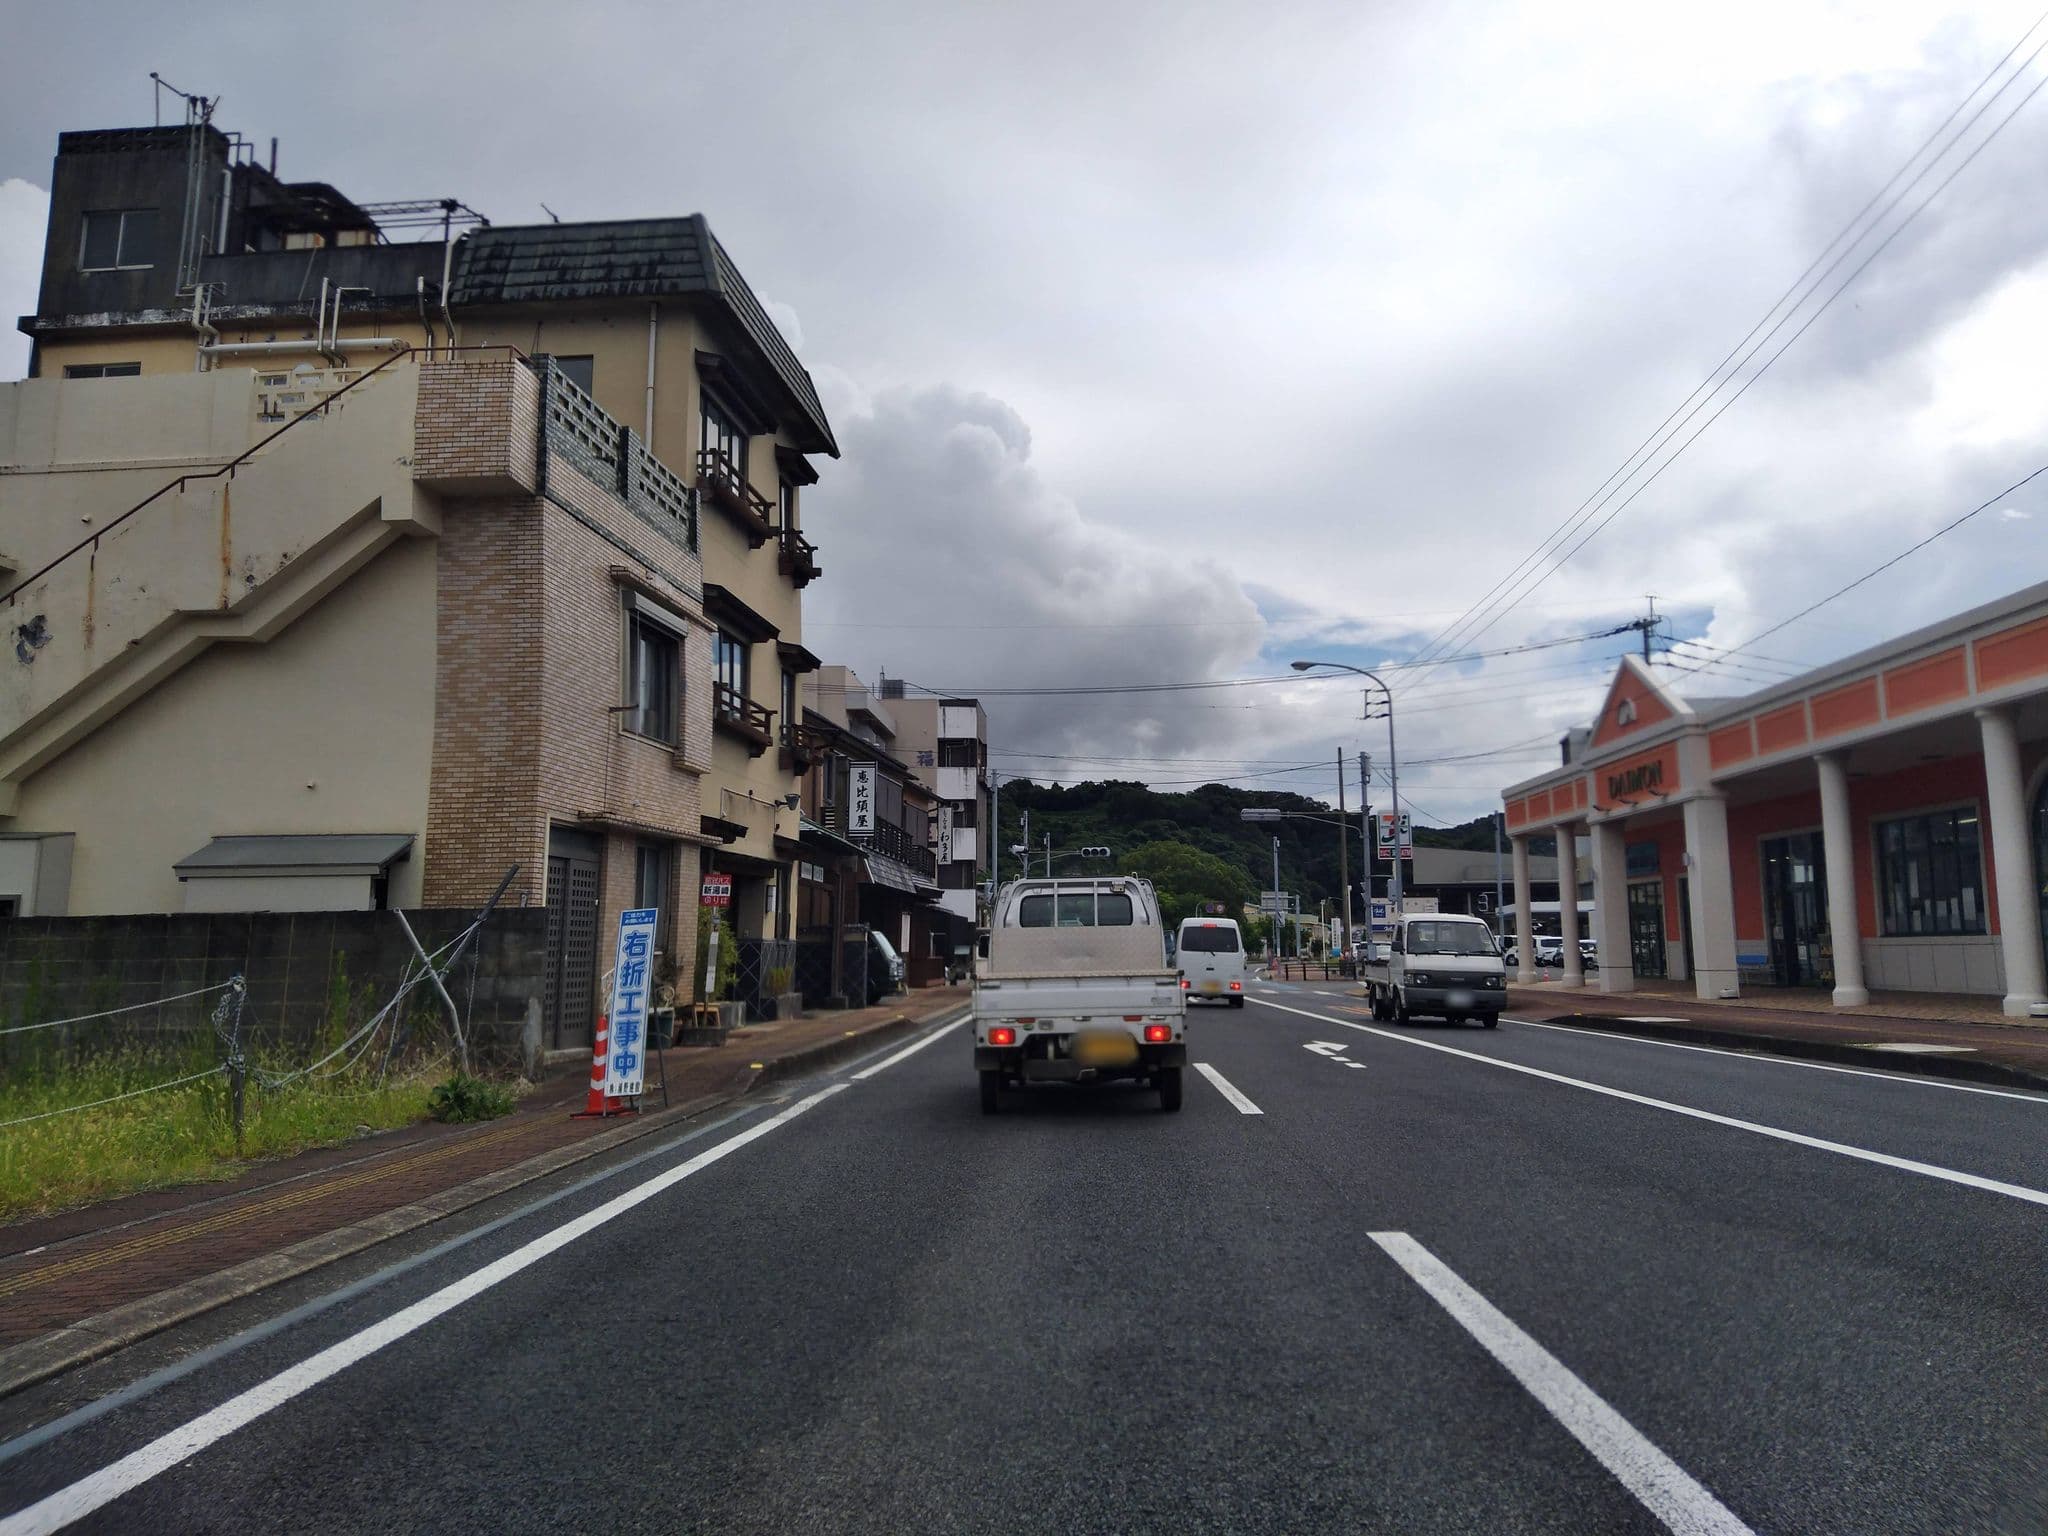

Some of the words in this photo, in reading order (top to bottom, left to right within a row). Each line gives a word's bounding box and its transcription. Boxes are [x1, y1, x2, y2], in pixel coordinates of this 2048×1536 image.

[855, 770, 869, 827] 恵比須屋
[614, 930, 650, 1077] 右折工事中
